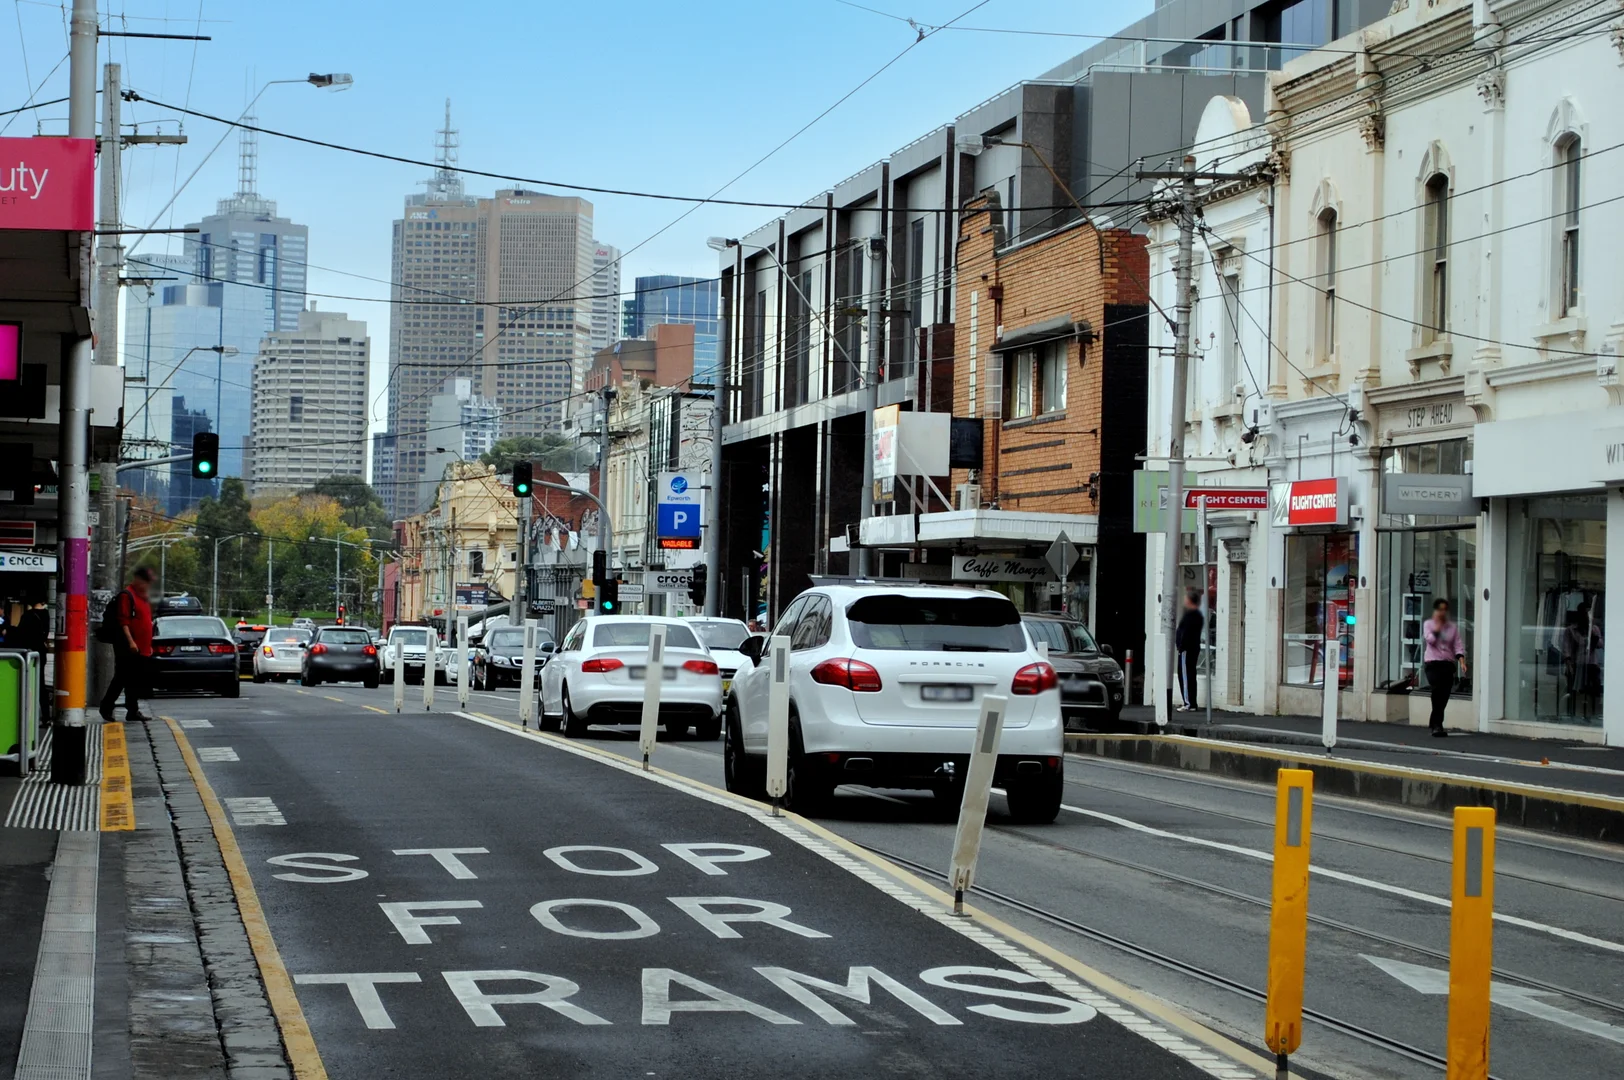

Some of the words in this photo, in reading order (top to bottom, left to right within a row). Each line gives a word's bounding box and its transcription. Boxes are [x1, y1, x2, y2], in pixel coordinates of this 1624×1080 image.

[1407, 406, 1426, 428] STEP
[1430, 403, 1453, 426] AHEAD
[1191, 496, 1227, 504] FGHT
[1227, 496, 1267, 504] CENTRE
[1291, 494, 1314, 511] FLIGHT
[1313, 493, 1337, 509] CENTRE
[1399, 489, 1459, 499] WITCHERY
[673, 511, 688, 530] P
[657, 575, 693, 584] crocs
[1004, 560, 1047, 580] Monza
[266, 842, 772, 884] STOP
[379, 895, 833, 946] FOR
[293, 964, 1099, 1031] TRAMS
